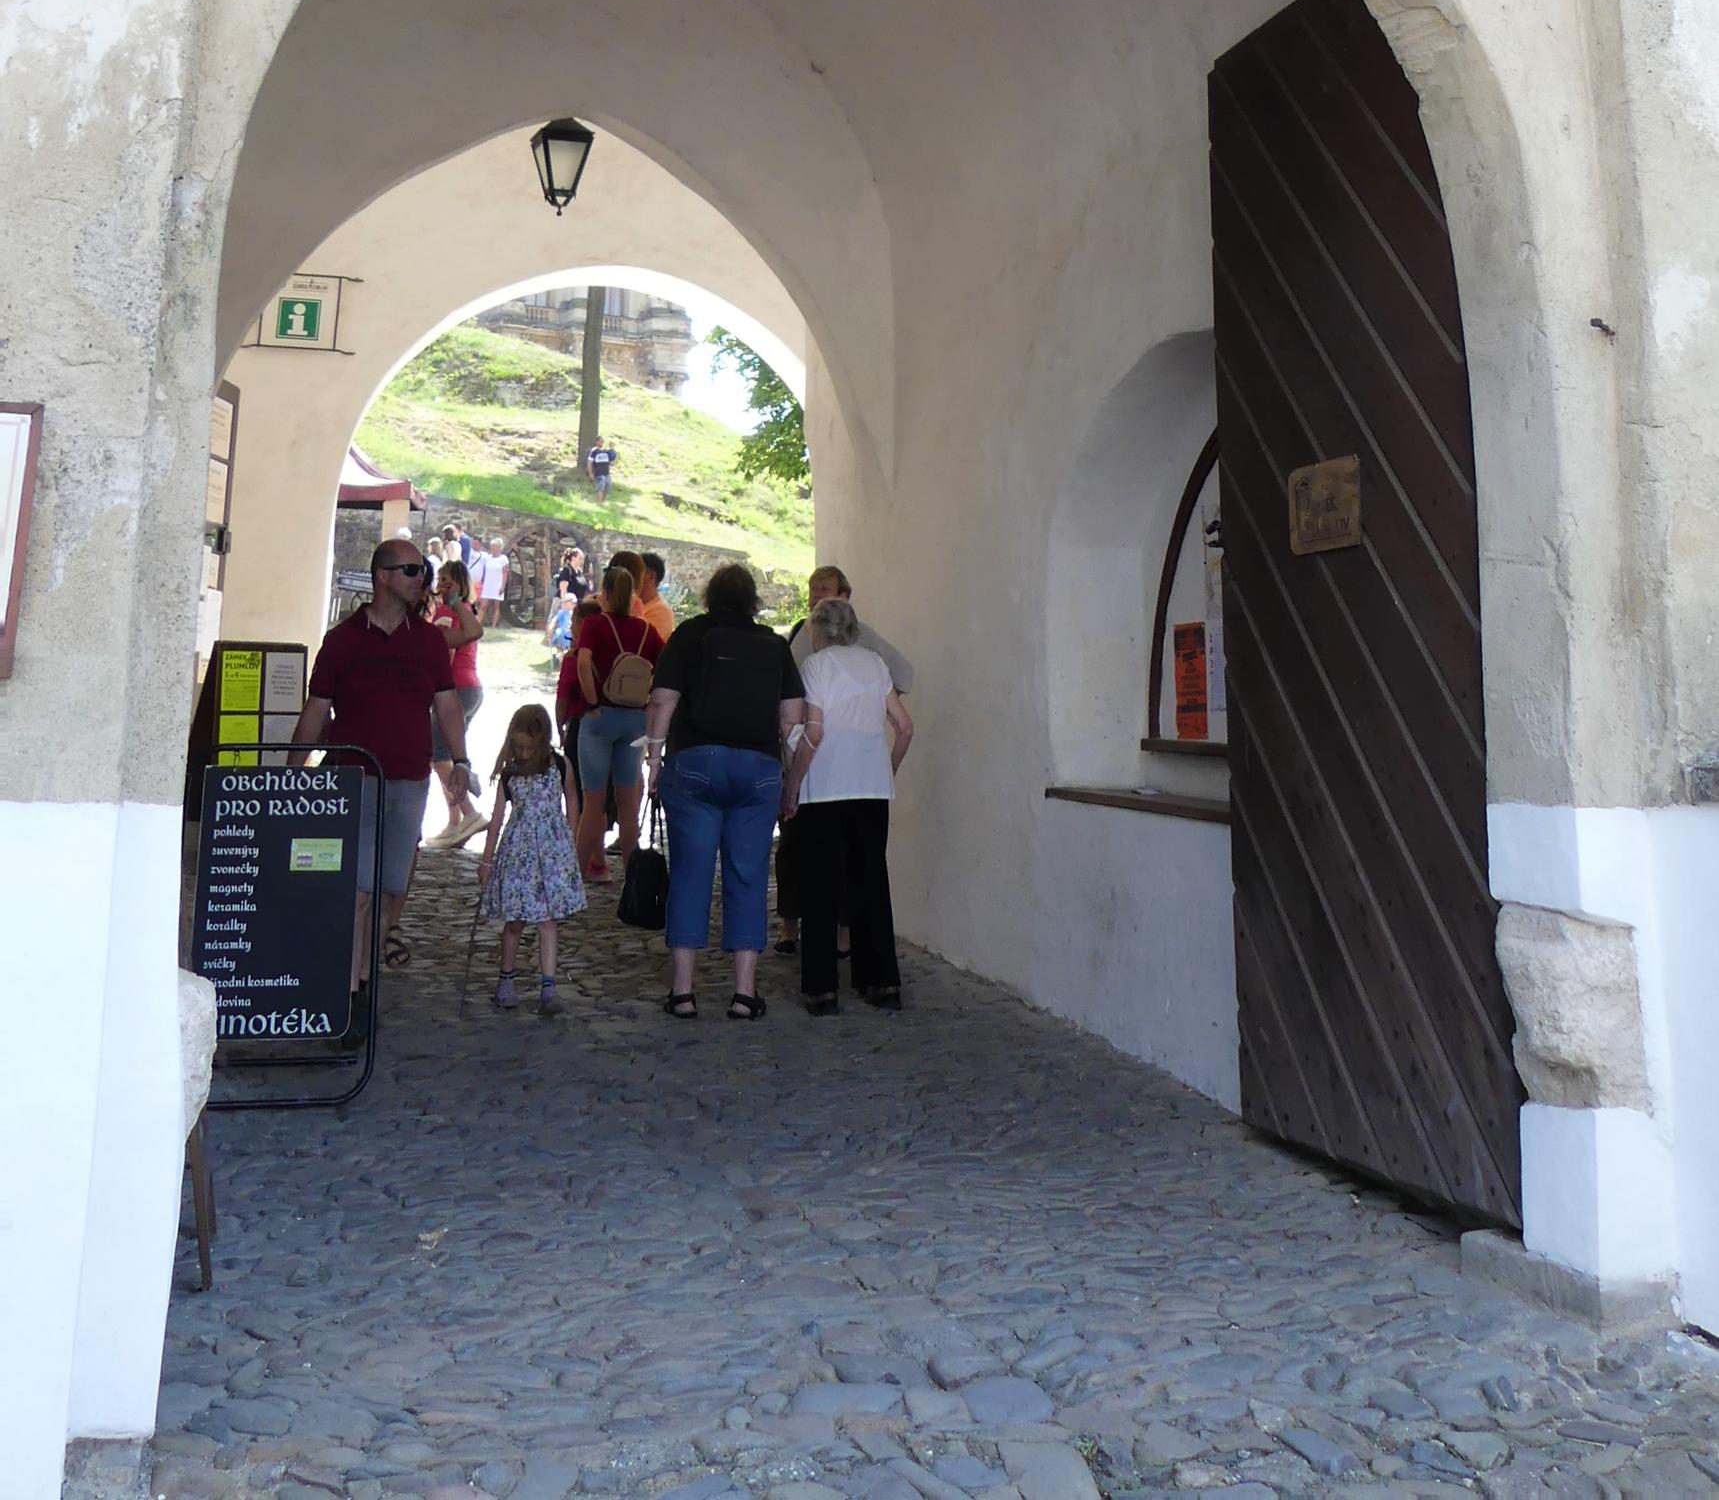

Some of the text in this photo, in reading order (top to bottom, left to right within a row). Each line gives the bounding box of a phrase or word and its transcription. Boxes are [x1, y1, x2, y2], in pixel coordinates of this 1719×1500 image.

[213, 824, 255, 840] pohledy
[210, 862, 260, 877] zvonečky
[209, 882, 254, 896] magnety
[207, 899, 257, 912] keramika
[206, 918, 247, 934] korálky
[204, 937, 252, 953] náramky
[202, 956, 237, 972] svíčky
[212, 974, 300, 988] írodní kosmetika
[216, 995, 252, 1008] dovina
[219, 1007, 332, 1035] inotéka
